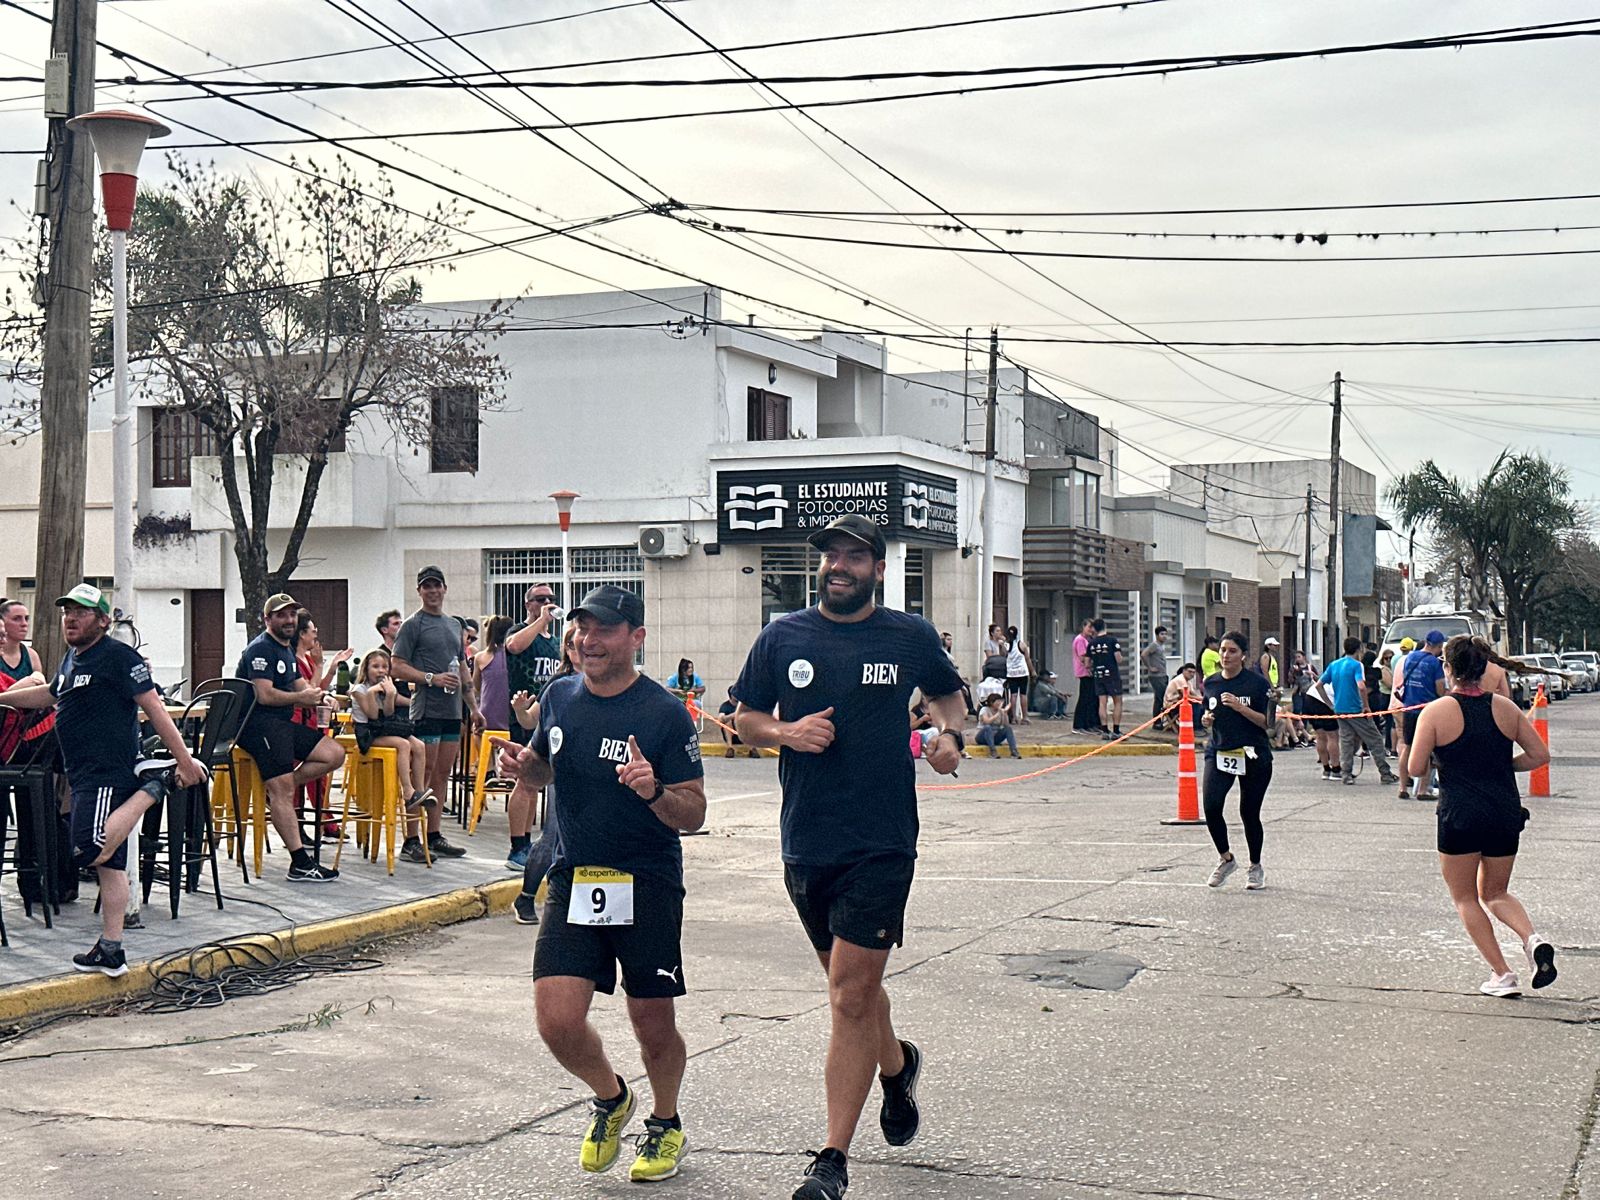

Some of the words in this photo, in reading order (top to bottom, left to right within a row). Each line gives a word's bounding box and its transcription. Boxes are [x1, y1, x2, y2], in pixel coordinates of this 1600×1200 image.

[798, 484, 811, 499] EL
[814, 481, 888, 499] ESTUDIANTE
[797, 499, 888, 514] FOTOCOPIAS
[797, 516, 807, 528] &
[809, 513, 889, 528] IMPRNES
[792, 670, 810, 679] TRIBU
[861, 663, 899, 685] BIEN
[1223, 757, 1238, 770] 52
[591, 887, 607, 914] 9
